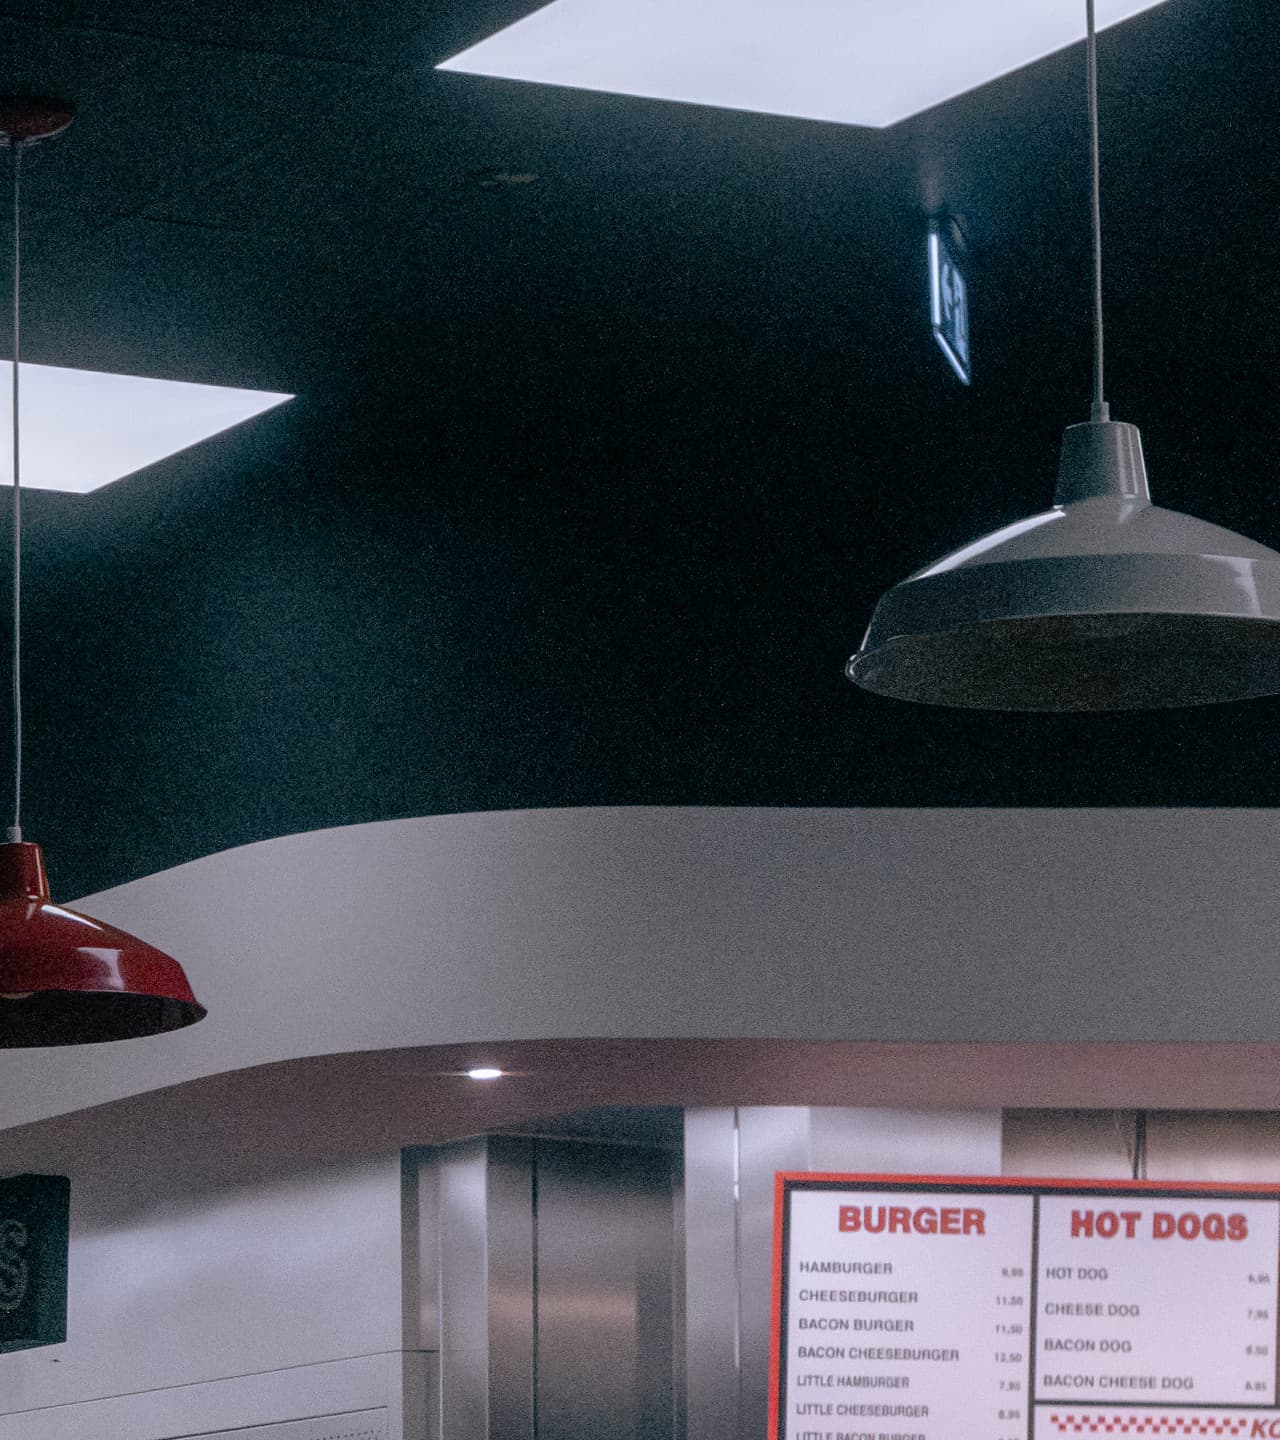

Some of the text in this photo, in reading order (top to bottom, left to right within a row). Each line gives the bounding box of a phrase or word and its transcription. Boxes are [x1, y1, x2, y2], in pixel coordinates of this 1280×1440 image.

[838, 1205, 986, 1236] BURGER
[1070, 1210, 1249, 1241] HOT DOGS
[799, 1261, 893, 1275] HAMBURGER
[1046, 1267, 1109, 1281] HOT DOG
[798, 1289, 919, 1304] CHEESEBURGER
[1044, 1302, 1140, 1318] CHEESE DOG
[798, 1317, 914, 1332] BACON BURGER
[1044, 1338, 1132, 1353] BACON DOG
[797, 1346, 960, 1362] BACON CHEESEBURGER
[796, 1374, 910, 1389] LITTLE HAMBURGER
[1043, 1374, 1194, 1390] BACON CHEESE DOG
[796, 1403, 929, 1418] LITTLE CHEESEBURGER
